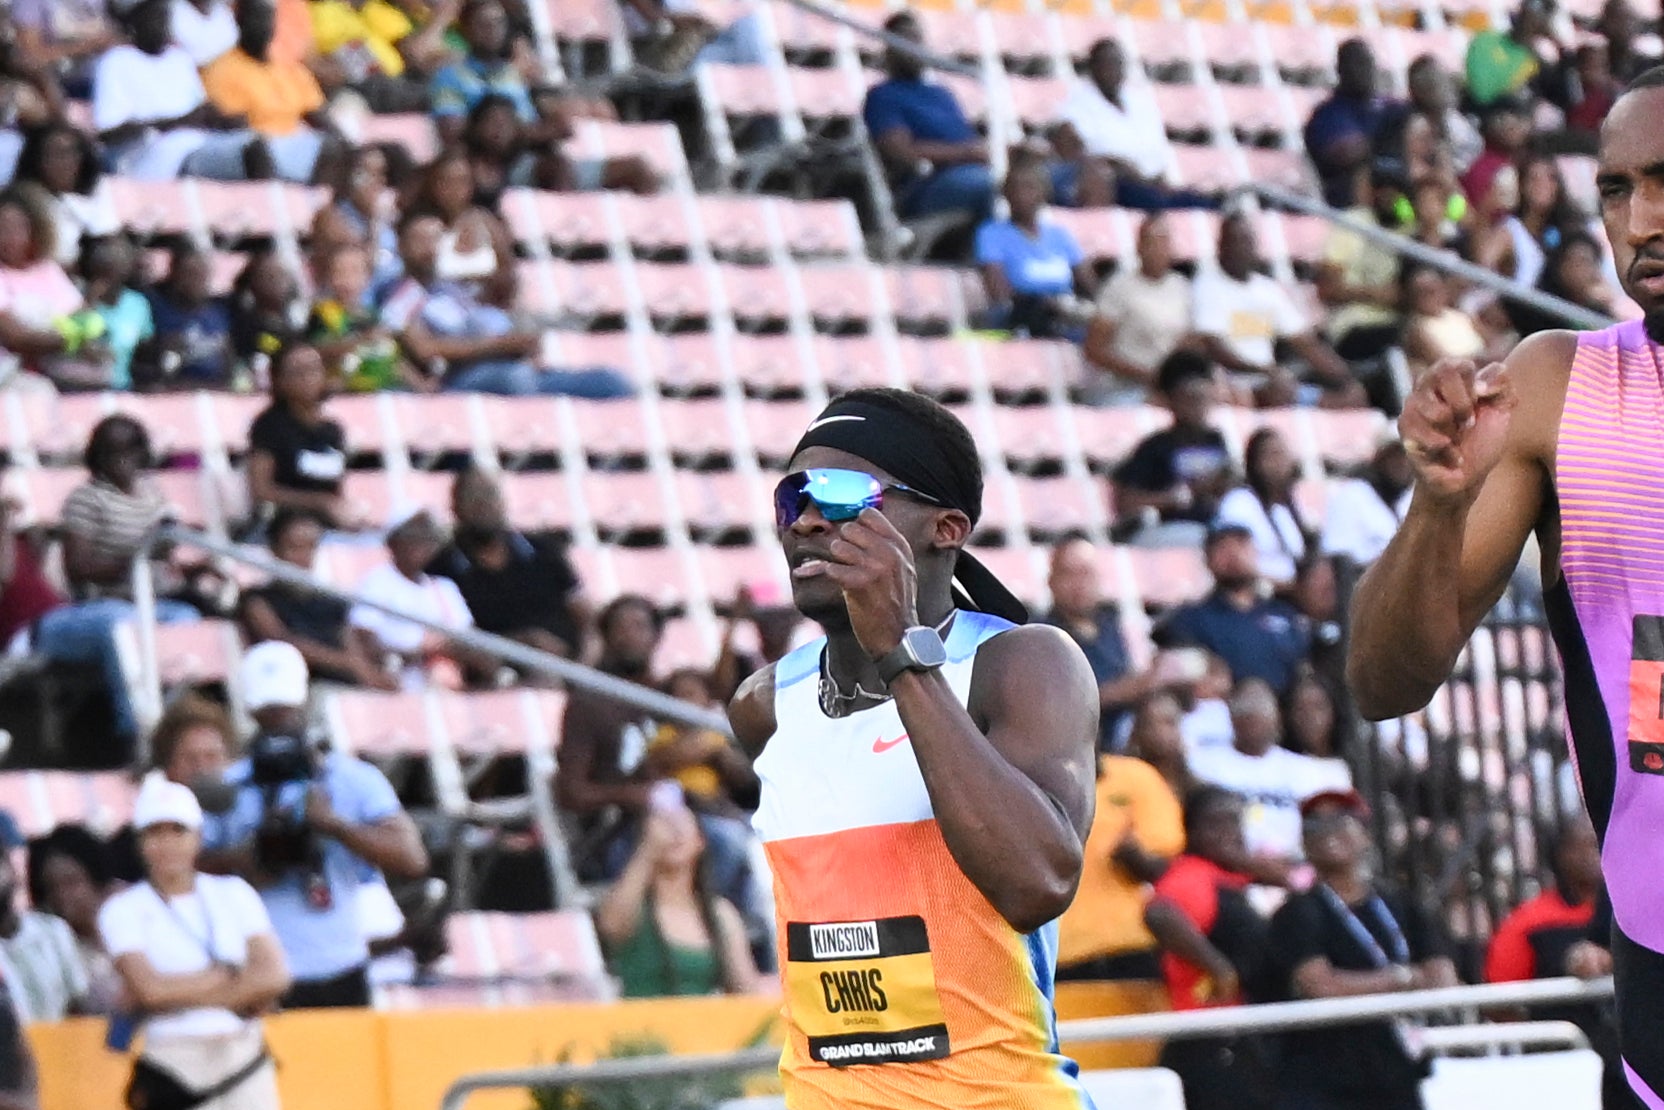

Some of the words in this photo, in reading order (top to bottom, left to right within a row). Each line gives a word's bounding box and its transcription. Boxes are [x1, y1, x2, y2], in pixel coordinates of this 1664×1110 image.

[813, 926, 876, 954] KINGSTON
[820, 968, 888, 1013] CHRIS
[819, 1044, 863, 1060] GRAND
[863, 1043, 892, 1056] SLAM
[890, 1037, 935, 1055] TRACK
